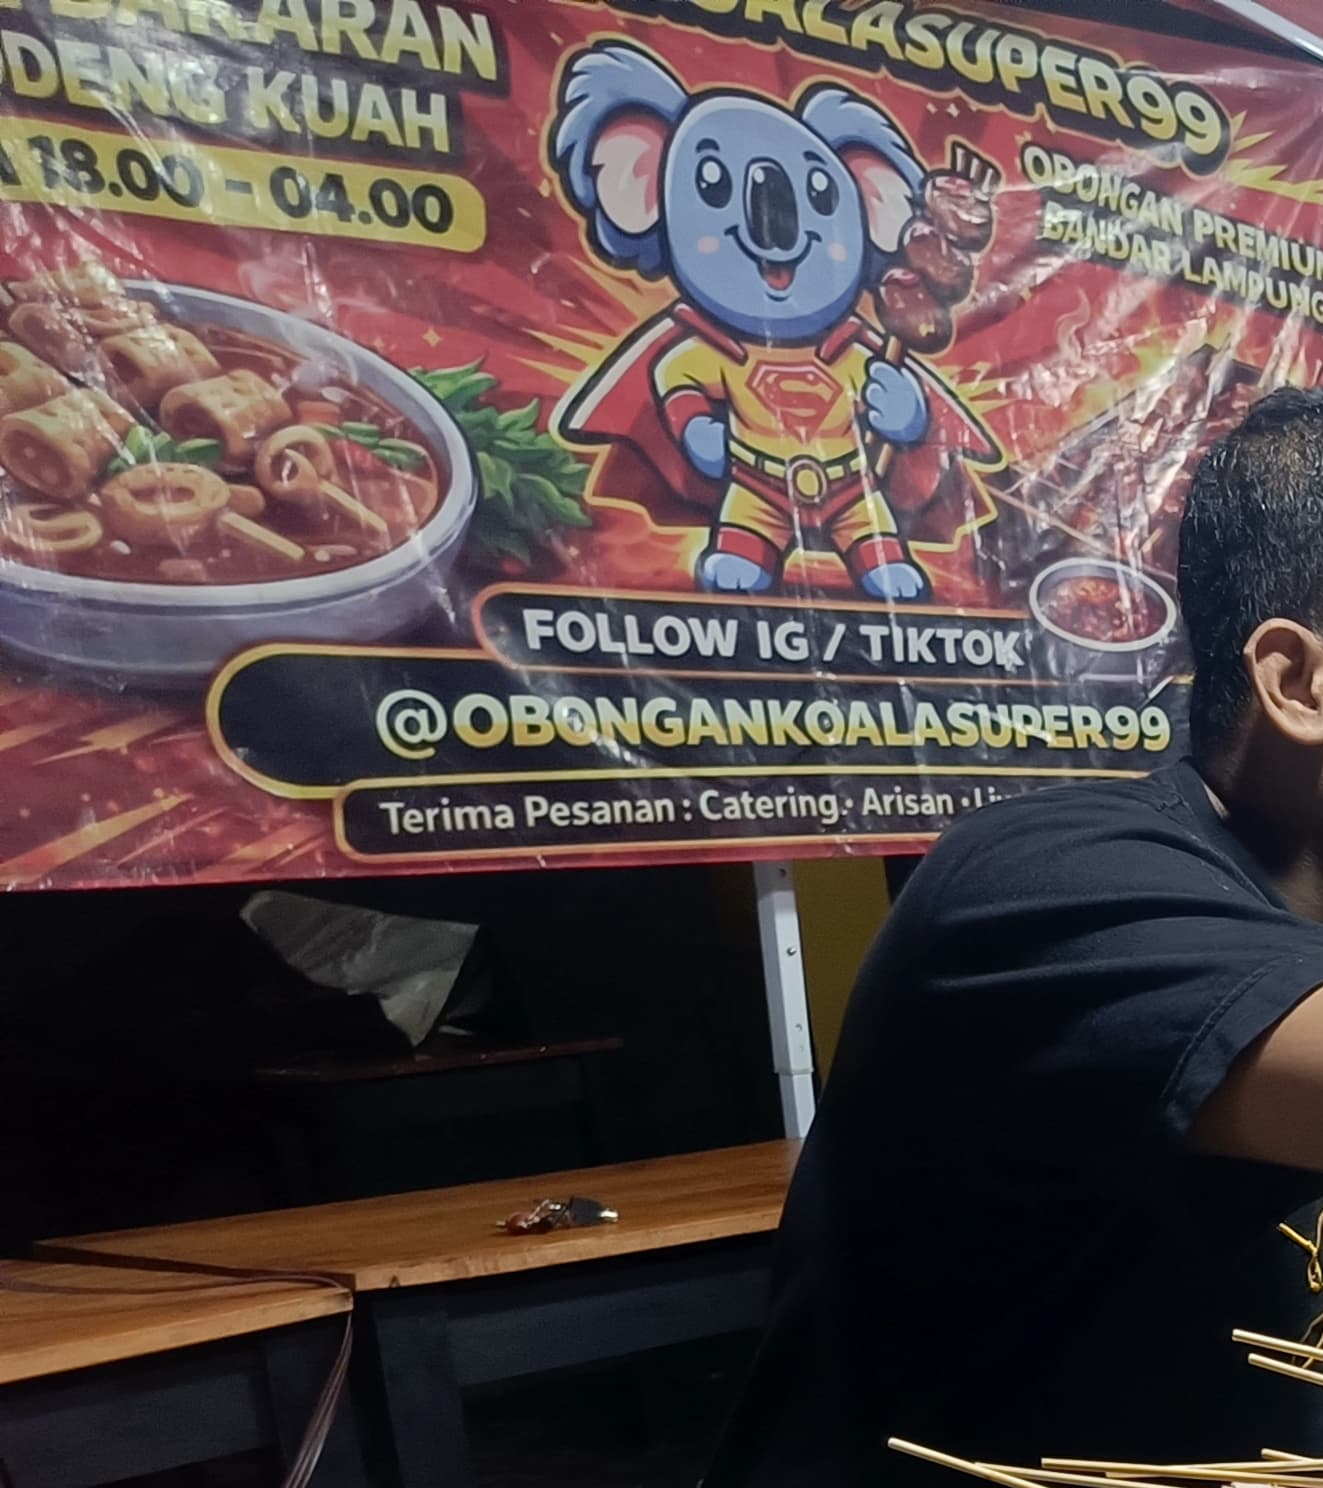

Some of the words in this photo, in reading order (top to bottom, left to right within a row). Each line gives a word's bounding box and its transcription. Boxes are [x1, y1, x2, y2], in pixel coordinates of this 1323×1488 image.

[52, 0, 497, 81] KARAN
[686, 0, 1222, 155] LASUPER99
[0, 30, 227, 124] DENG
[246, 65, 449, 153] KUAH
[28, 135, 204, 208] 18.00
[269, 165, 454, 235] 04.00
[1023, 145, 1184, 235] OBONGAN
[1043, 201, 1171, 274] BANDAR
[522, 609, 738, 658] FOLLOW
[757, 619, 809, 661] IG
[859, 623, 1025, 668] TIKTOK
[376, 688, 1171, 760] @OBONGANKOALASUPER99
[379, 797, 515, 835] Terima
[525, 795, 675, 827] Pesanan
[861, 784, 955, 817] Arisan
